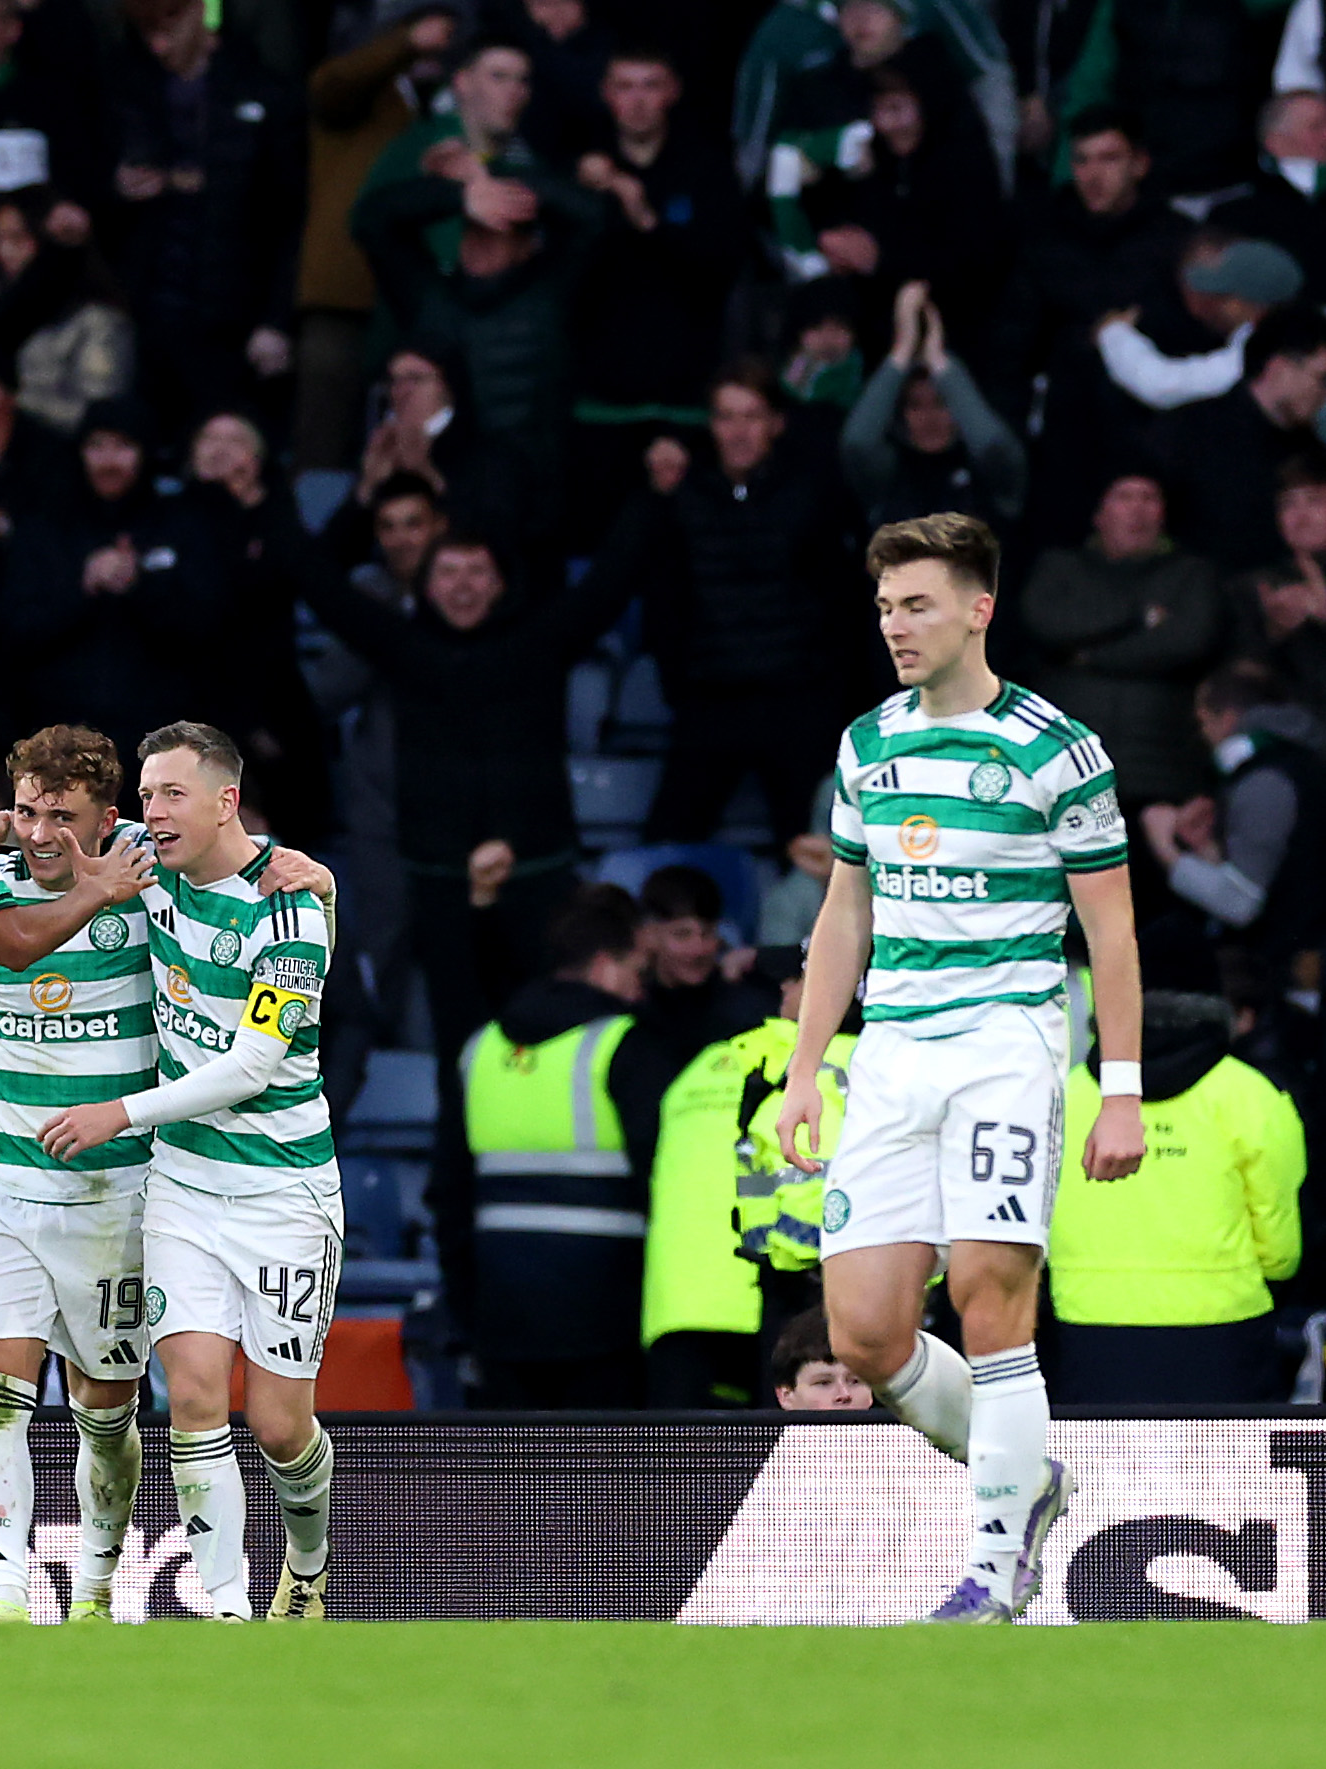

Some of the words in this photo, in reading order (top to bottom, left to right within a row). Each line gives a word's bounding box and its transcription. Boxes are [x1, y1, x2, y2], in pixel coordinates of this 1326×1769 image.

[876, 864, 990, 901] dafabet
[275, 957, 306, 975] CELTIC
[306, 960, 318, 976] FC
[156, 990, 230, 1050] afabet
[251, 989, 278, 1025] C
[971, 1121, 1037, 1187] 63
[96, 1278, 143, 1330] 19
[259, 1266, 316, 1323] 42
